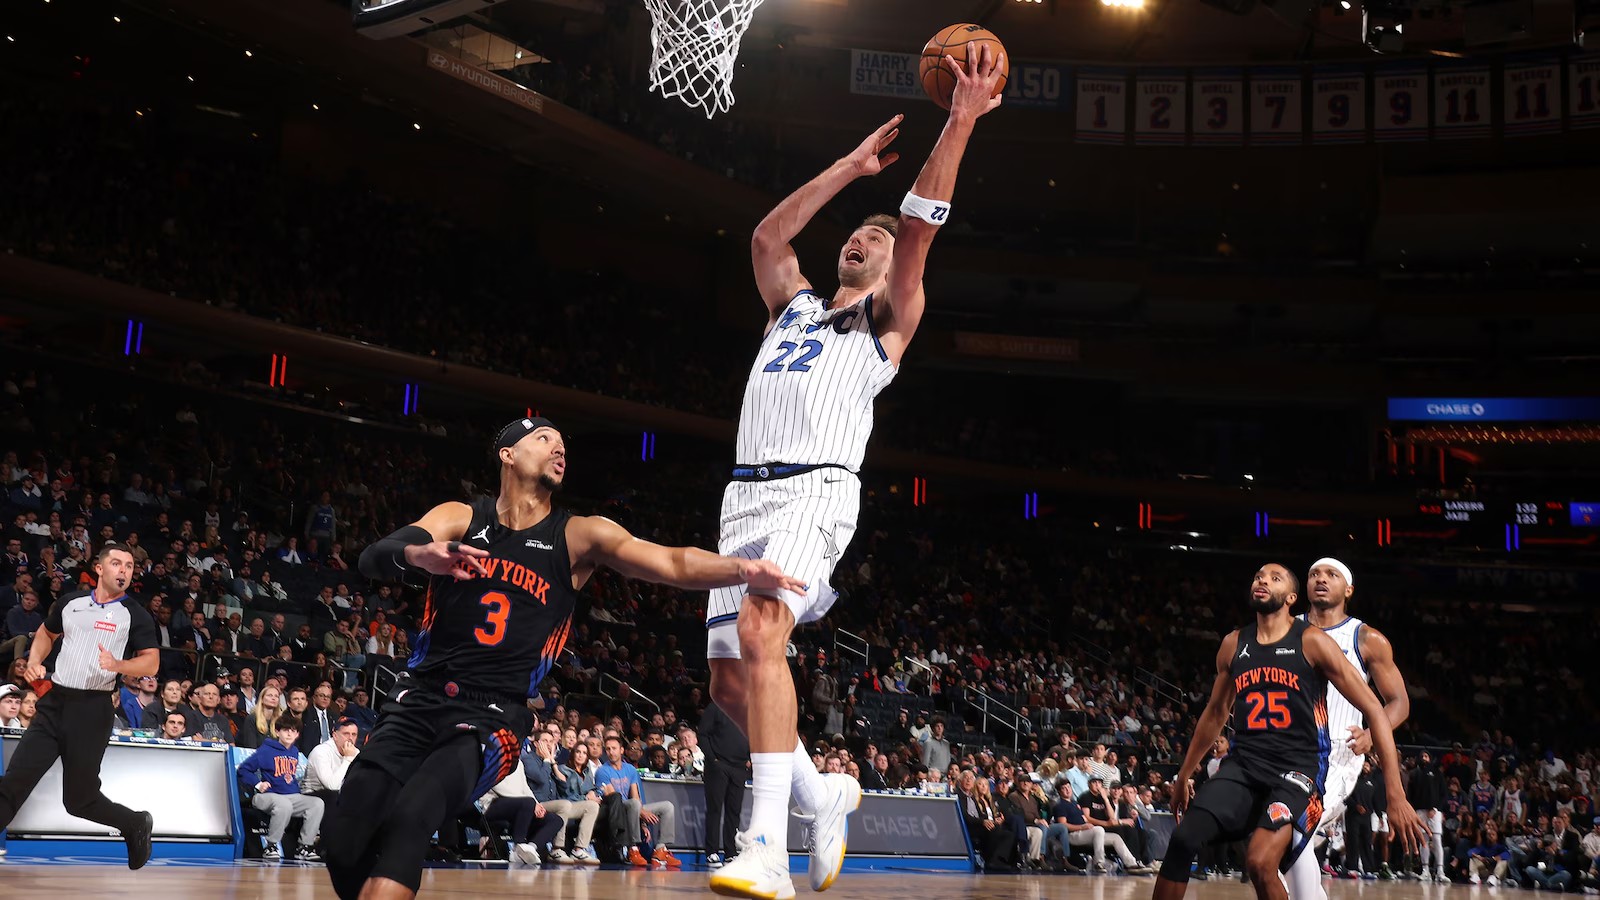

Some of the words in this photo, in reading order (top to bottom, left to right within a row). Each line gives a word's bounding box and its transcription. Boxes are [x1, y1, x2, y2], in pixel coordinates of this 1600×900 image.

[856, 67, 914, 87] STYLES
[860, 53, 910, 71] HARRY
[451, 62, 501, 92] HYUNDAI
[503, 84, 543, 110] BRIDGE
[1514, 83, 1550, 119] 11
[1093, 96, 1108, 128] 1
[1150, 96, 1171, 129] 2
[1207, 97, 1228, 130] 3
[1264, 96, 1286, 129] 7
[1328, 94, 1350, 127] 9
[1390, 91, 1412, 125] 9
[1445, 88, 1480, 123] 11
[930, 206, 948, 221] 22
[763, 339, 825, 373] 22
[1426, 403, 1471, 416] CHASE
[1444, 500, 1485, 512] LAKERS
[453, 556, 500, 584] EW
[499, 556, 551, 606] YORK
[473, 590, 513, 647] 3
[1234, 667, 1262, 694] NEW
[1262, 666, 1301, 692] YORK
[1245, 690, 1293, 731] 25
[863, 814, 920, 837] CHASE
